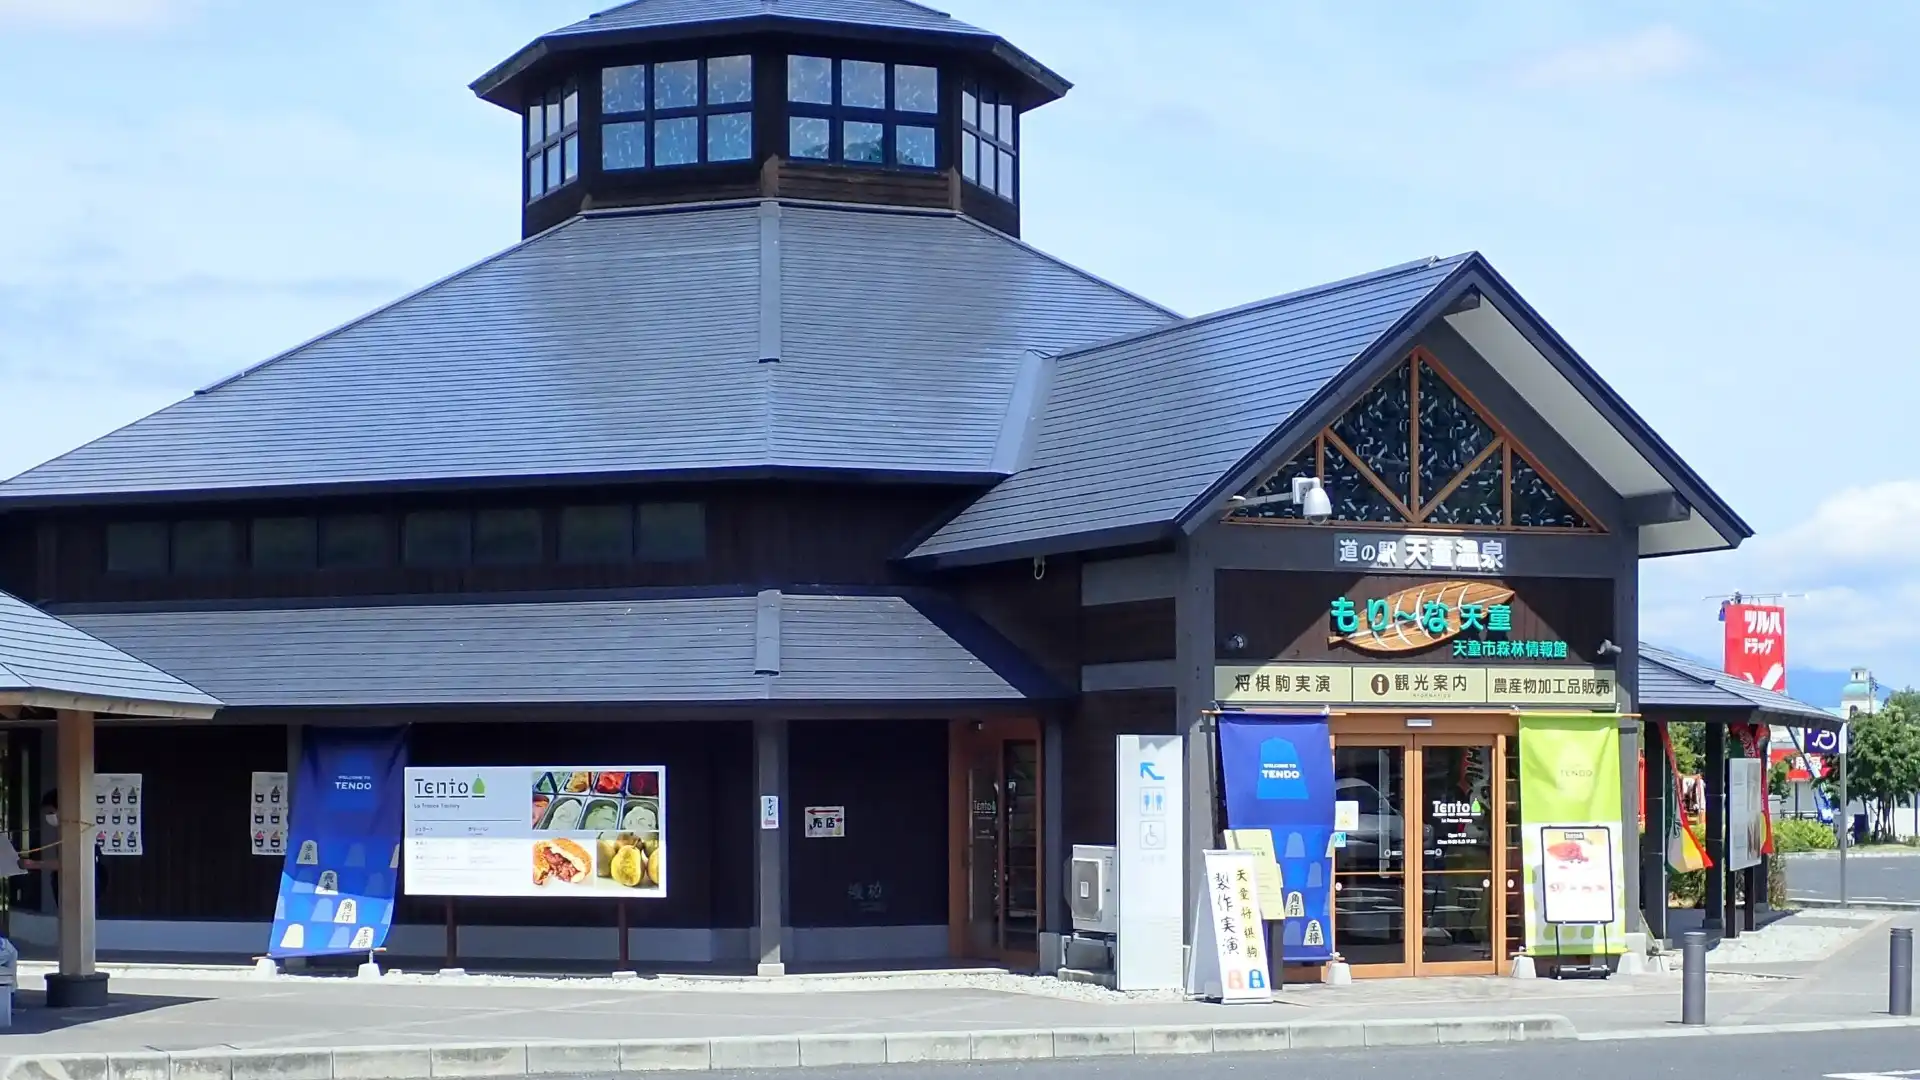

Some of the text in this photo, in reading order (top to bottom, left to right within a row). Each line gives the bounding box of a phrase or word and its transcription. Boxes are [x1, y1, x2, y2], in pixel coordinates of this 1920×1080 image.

[1744, 610, 1782, 635] ツルハ
[1452, 639, 1568, 659] 天童市森林情報館
[1744, 637, 1775, 656] ドラッグ
[1234, 674, 1332, 693] 将棋駒実演
[1394, 673, 1468, 692] 観光案内
[1493, 677, 1611, 696] 農産物加工品販売
[1262, 769, 1301, 779] TENDO
[335, 781, 372, 790] TENDO
[414, 779, 469, 795] Tento
[1432, 800, 1471, 813] Tento
[1214, 872, 1240, 956] 製作実演
[1290, 893, 1300, 916] 角行
[1308, 922, 1320, 944] 王将
